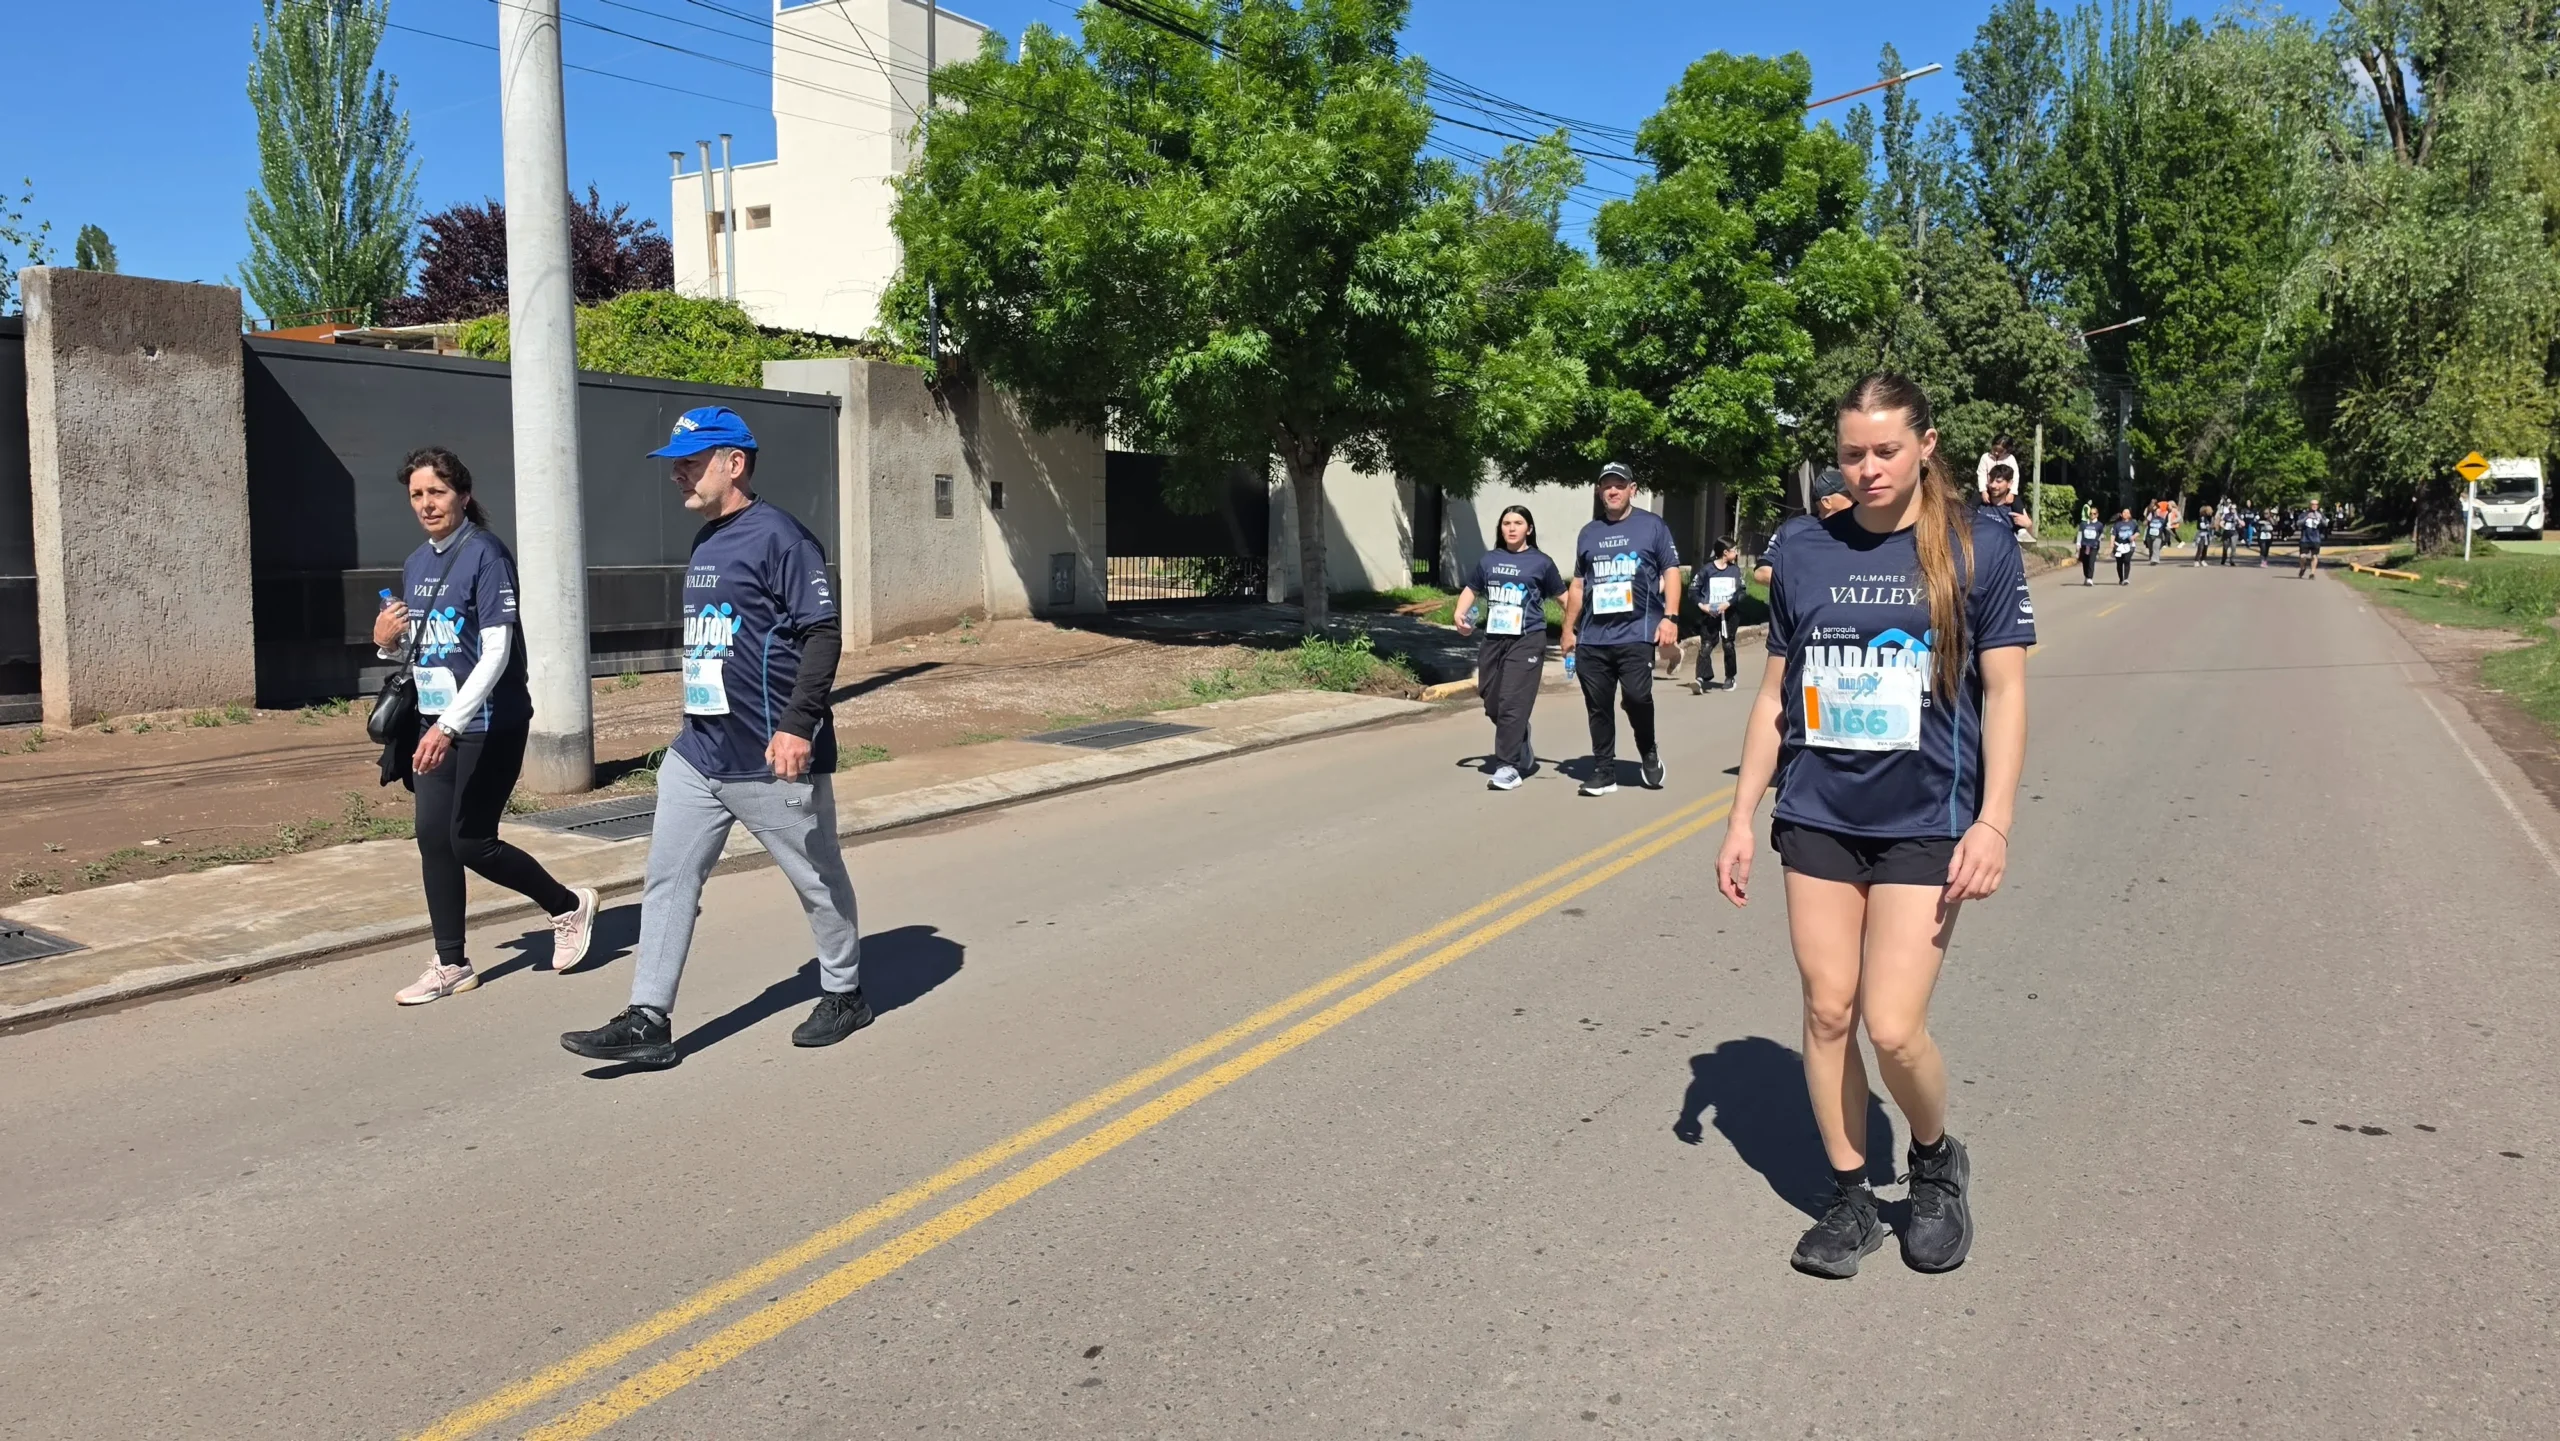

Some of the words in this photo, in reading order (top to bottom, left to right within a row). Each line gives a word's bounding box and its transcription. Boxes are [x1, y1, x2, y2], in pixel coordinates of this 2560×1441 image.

[1598, 538, 1630, 548] VALLEY
[686, 575, 720, 588] VALLEY
[1849, 574, 1906, 582] PALMARES
[1830, 587, 1922, 605] VALLEY
[1823, 626, 1856, 634] parroquia
[419, 691, 445, 706] 86
[685, 686, 709, 704] 89
[1830, 707, 1888, 735] 166
